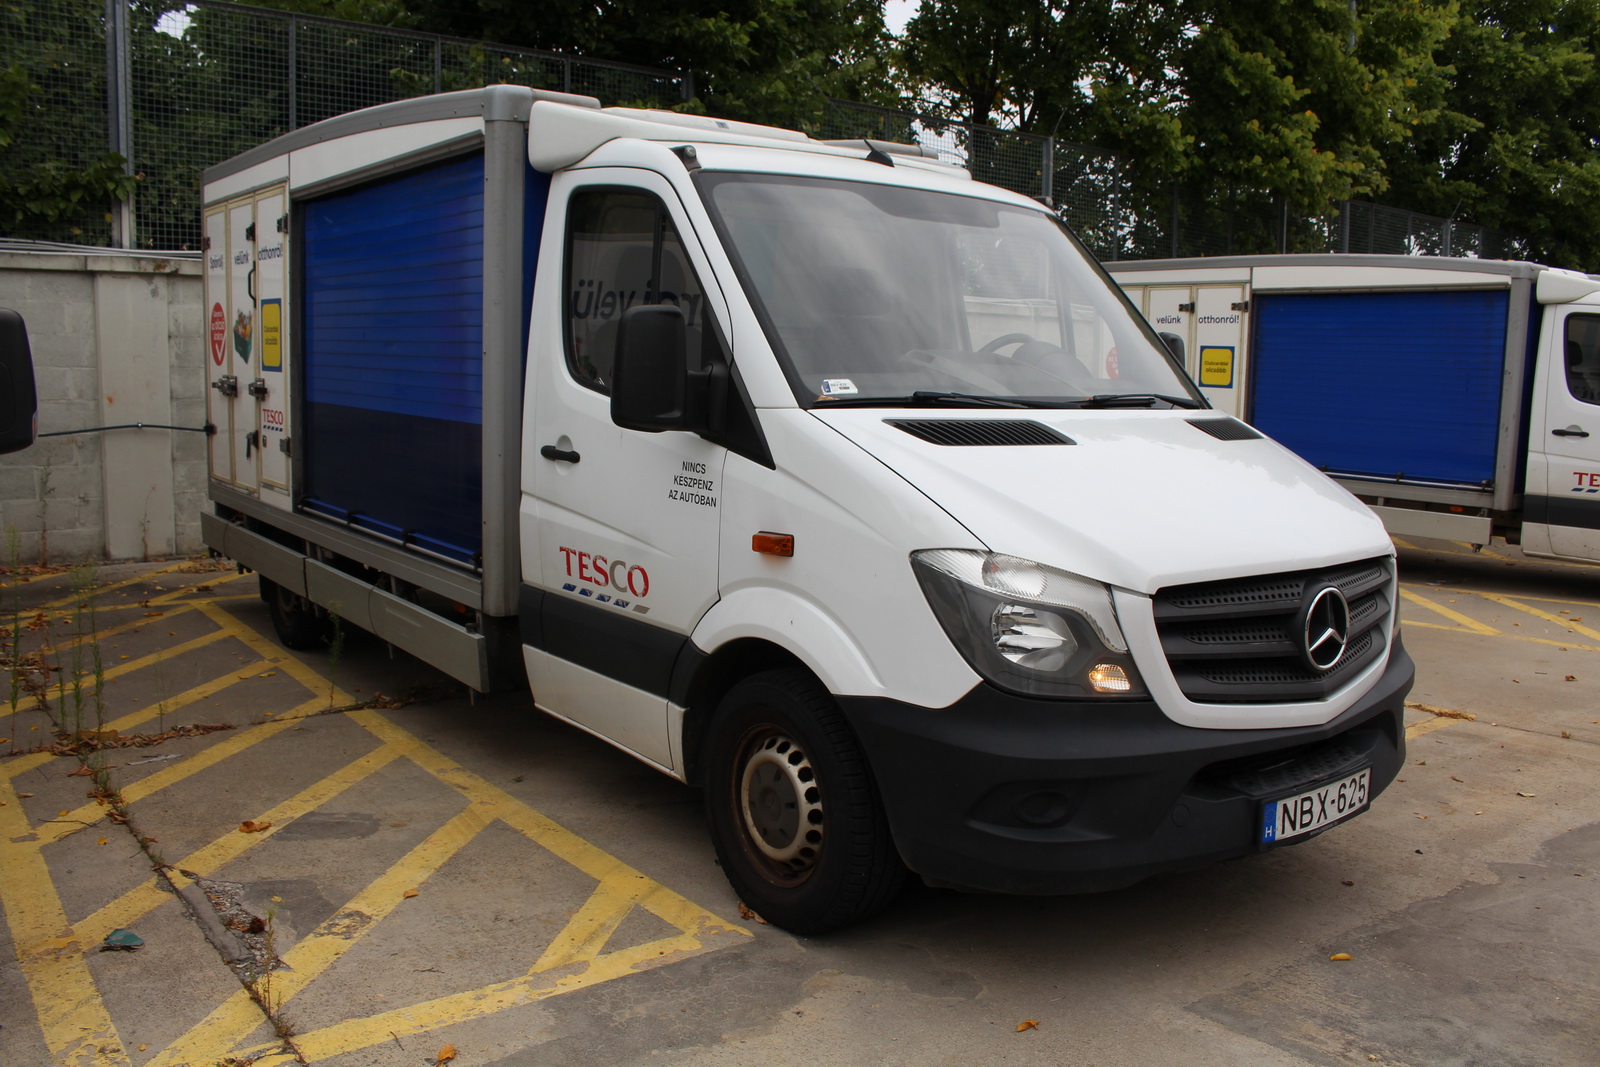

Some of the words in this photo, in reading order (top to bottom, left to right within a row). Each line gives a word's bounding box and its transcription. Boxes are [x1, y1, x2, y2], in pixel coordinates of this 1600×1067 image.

[234, 250, 250, 265] velünk
[258, 243, 283, 261] otthonról!
[1156, 315, 1182, 324] velünk
[1198, 315, 1240, 324] otthonról!
[262, 408, 284, 425] TESCO
[681, 460, 707, 475] NINCS
[673, 473, 714, 492] KÉSZPÉNZ
[668, 489, 679, 501] AZ
[679, 491, 717, 508] AUTÓBAN
[559, 545, 650, 598] TESCO
[1264, 825, 1273, 838] H
[1281, 772, 1367, 835] NBX-625
